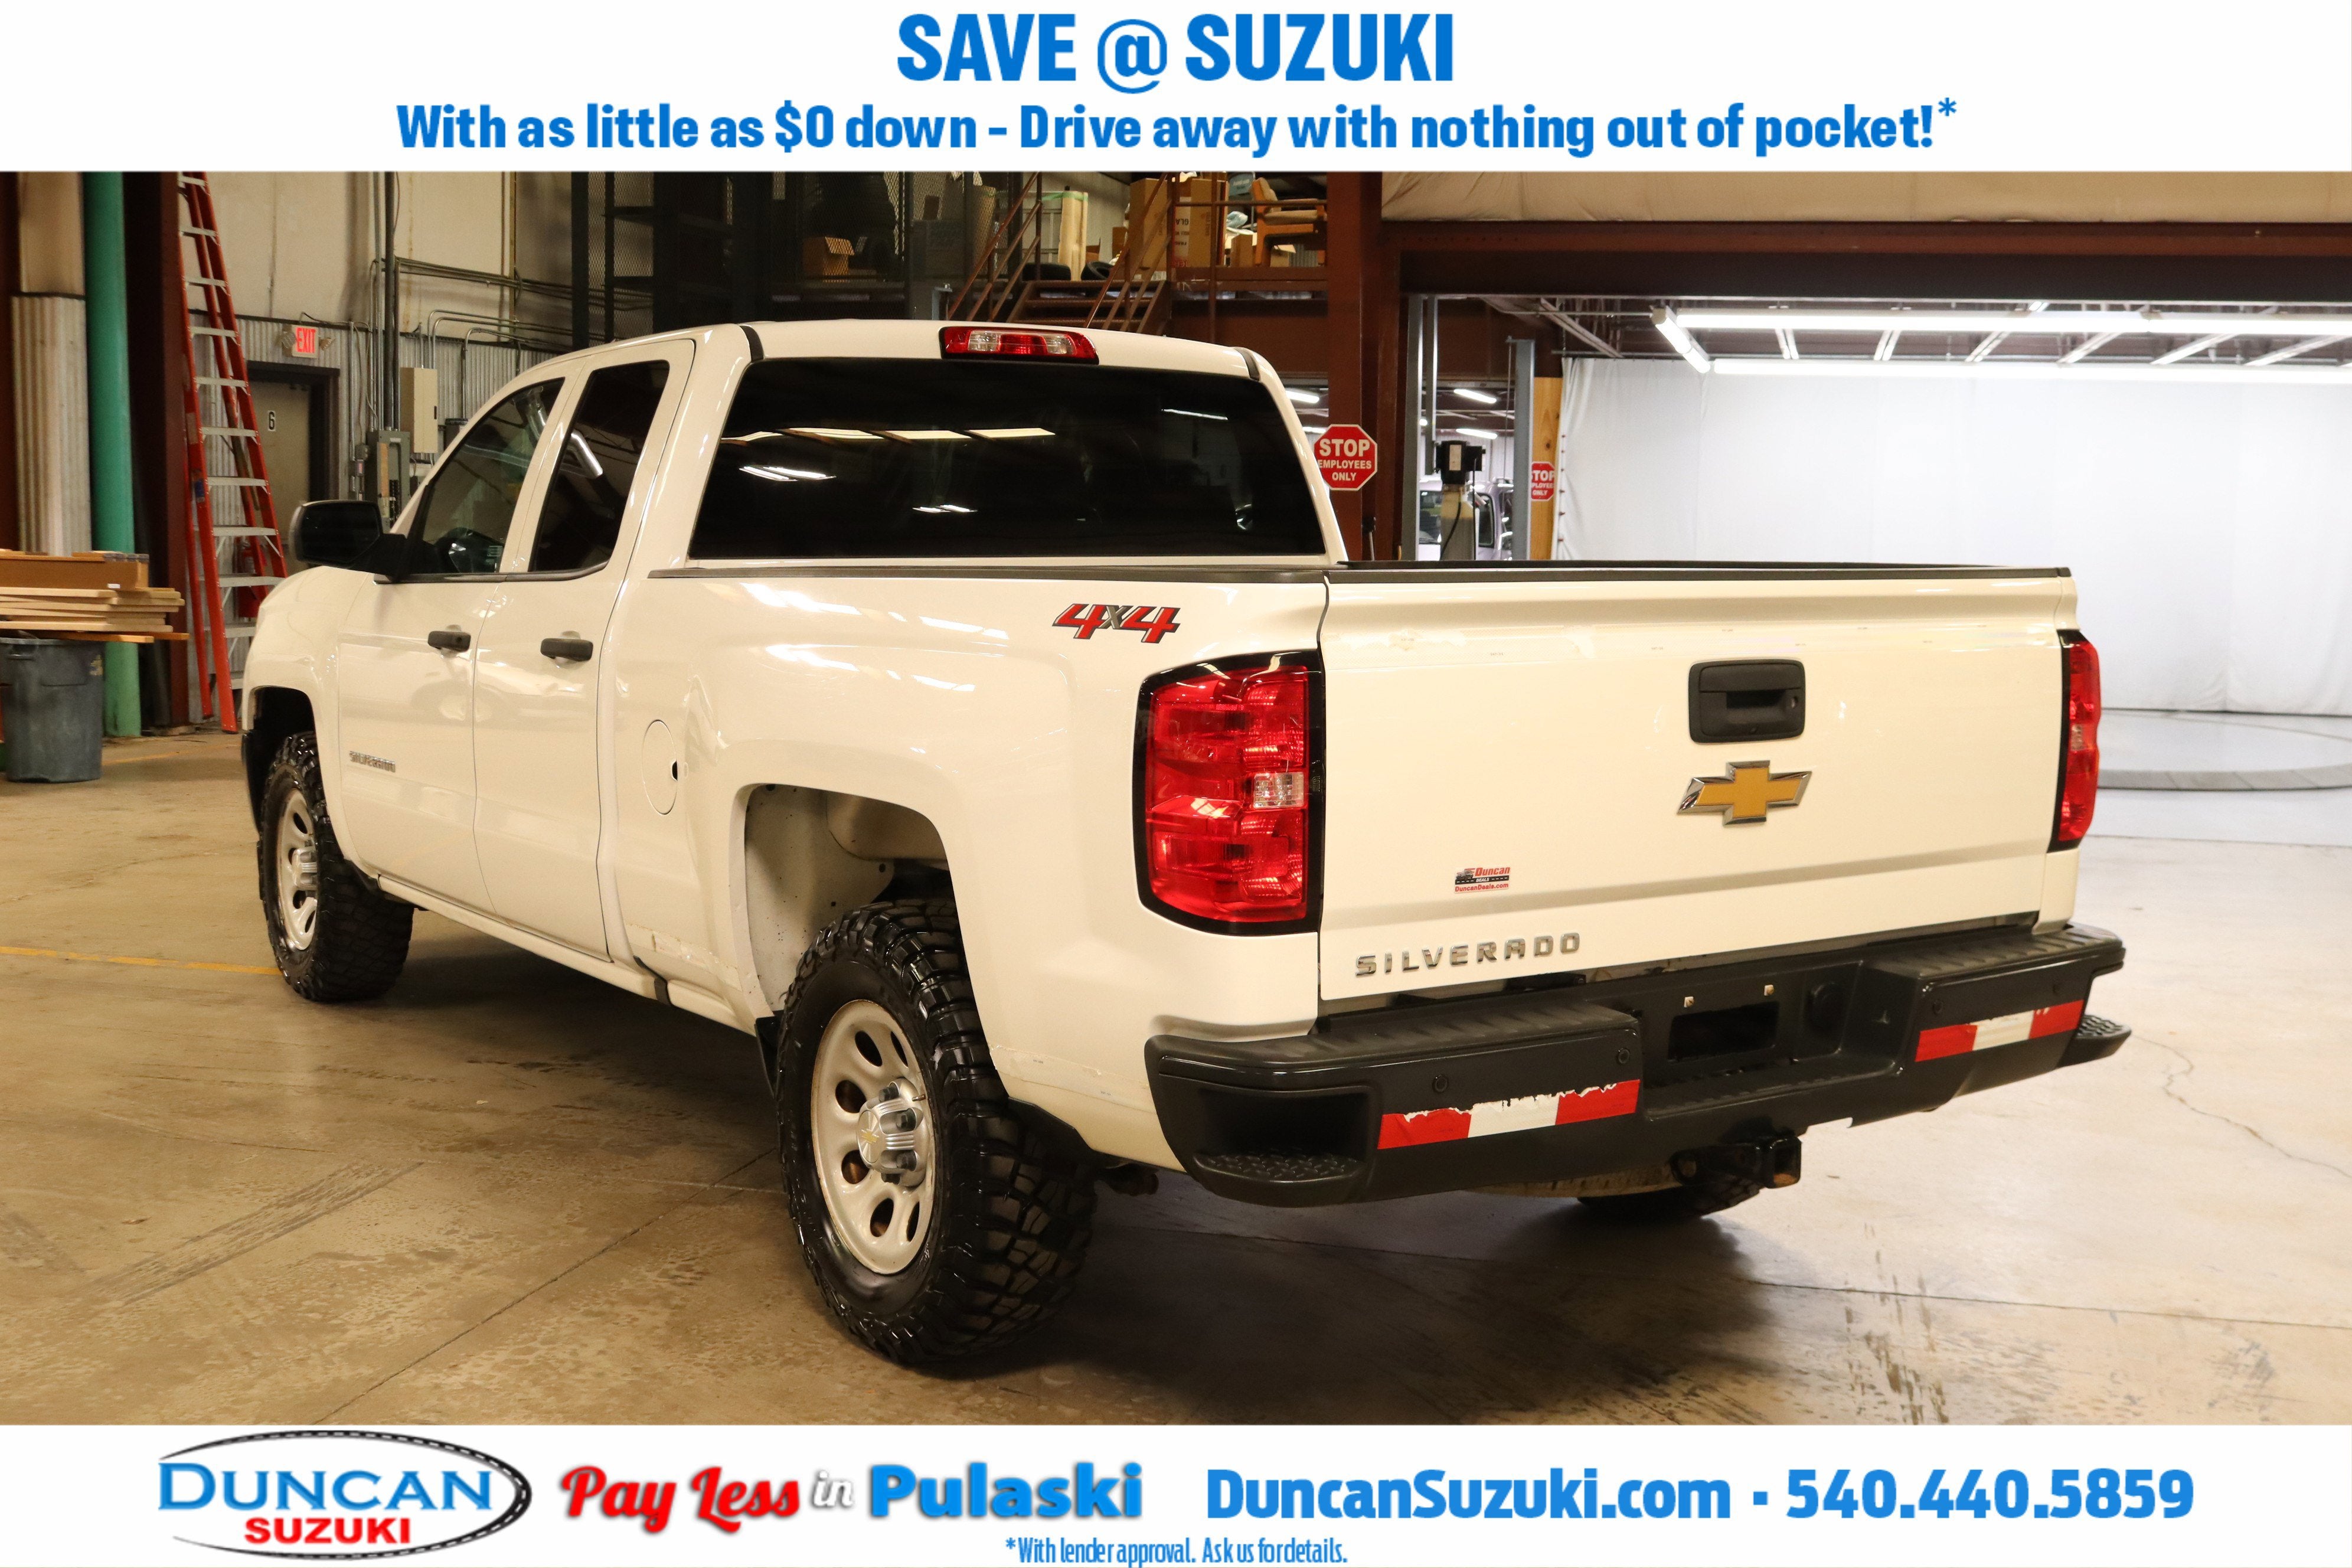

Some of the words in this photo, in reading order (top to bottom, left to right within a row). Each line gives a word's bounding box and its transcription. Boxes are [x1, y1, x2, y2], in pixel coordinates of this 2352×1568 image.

[296, 327, 316, 353] EXIT
[269, 411, 275, 430] 6
[1319, 439, 1370, 457] STOP
[1318, 459, 1372, 469] EMPLOYEES
[1332, 472, 1357, 481] ONLY
[1532, 470, 1555, 481] TOP
[1475, 867, 1510, 877] Duncan
[1455, 883, 1509, 892] DuncanDeals.com
[1355, 932, 1580, 978] SILVERADO
